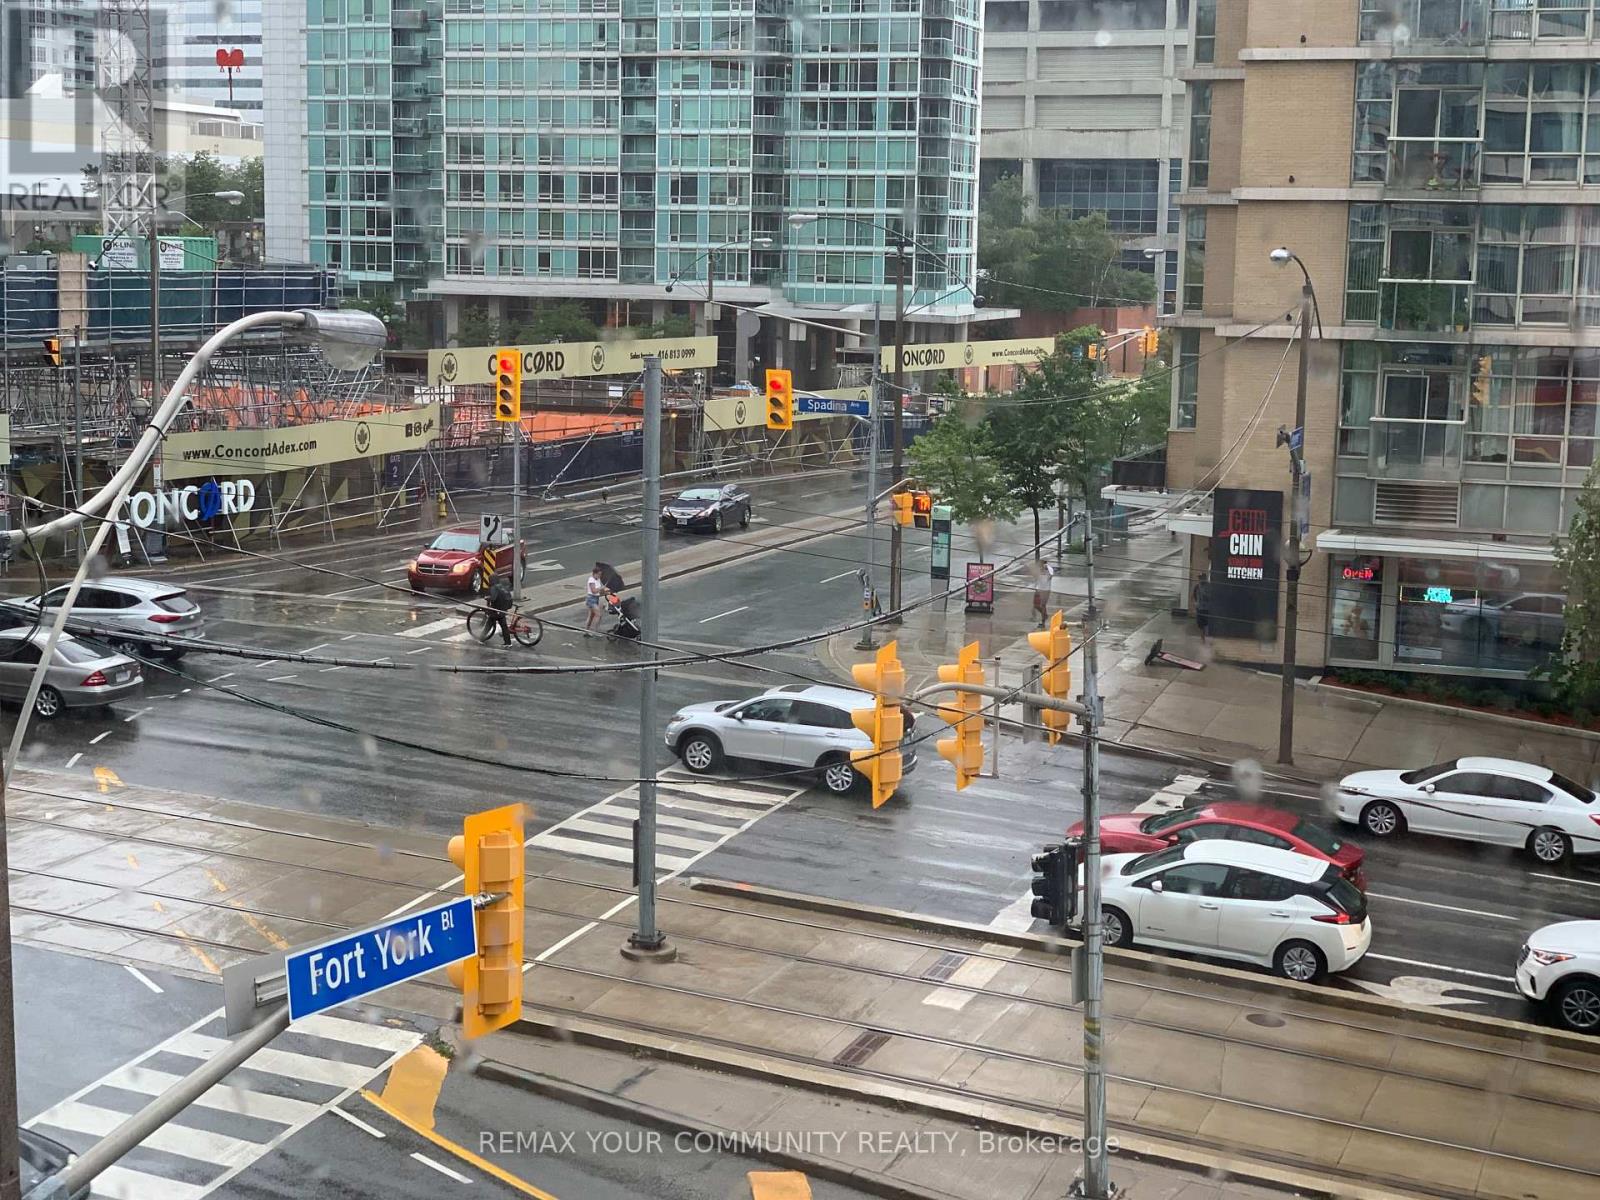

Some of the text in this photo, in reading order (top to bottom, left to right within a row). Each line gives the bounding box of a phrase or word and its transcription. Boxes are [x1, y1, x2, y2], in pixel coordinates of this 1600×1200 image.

[670, 349, 680, 359] 813
[681, 348, 695, 358] 0999
[903, 348, 945, 367] ONCØRD
[808, 398, 847, 412] Spadina
[183, 438, 317, 460] www.ConcordAdex.com
[1229, 533, 1263, 556] CHIN
[1227, 566, 1263, 580] KITCHEN
[1343, 568, 1374, 580] OPEN
[309, 909, 455, 996] Fort York Bl
